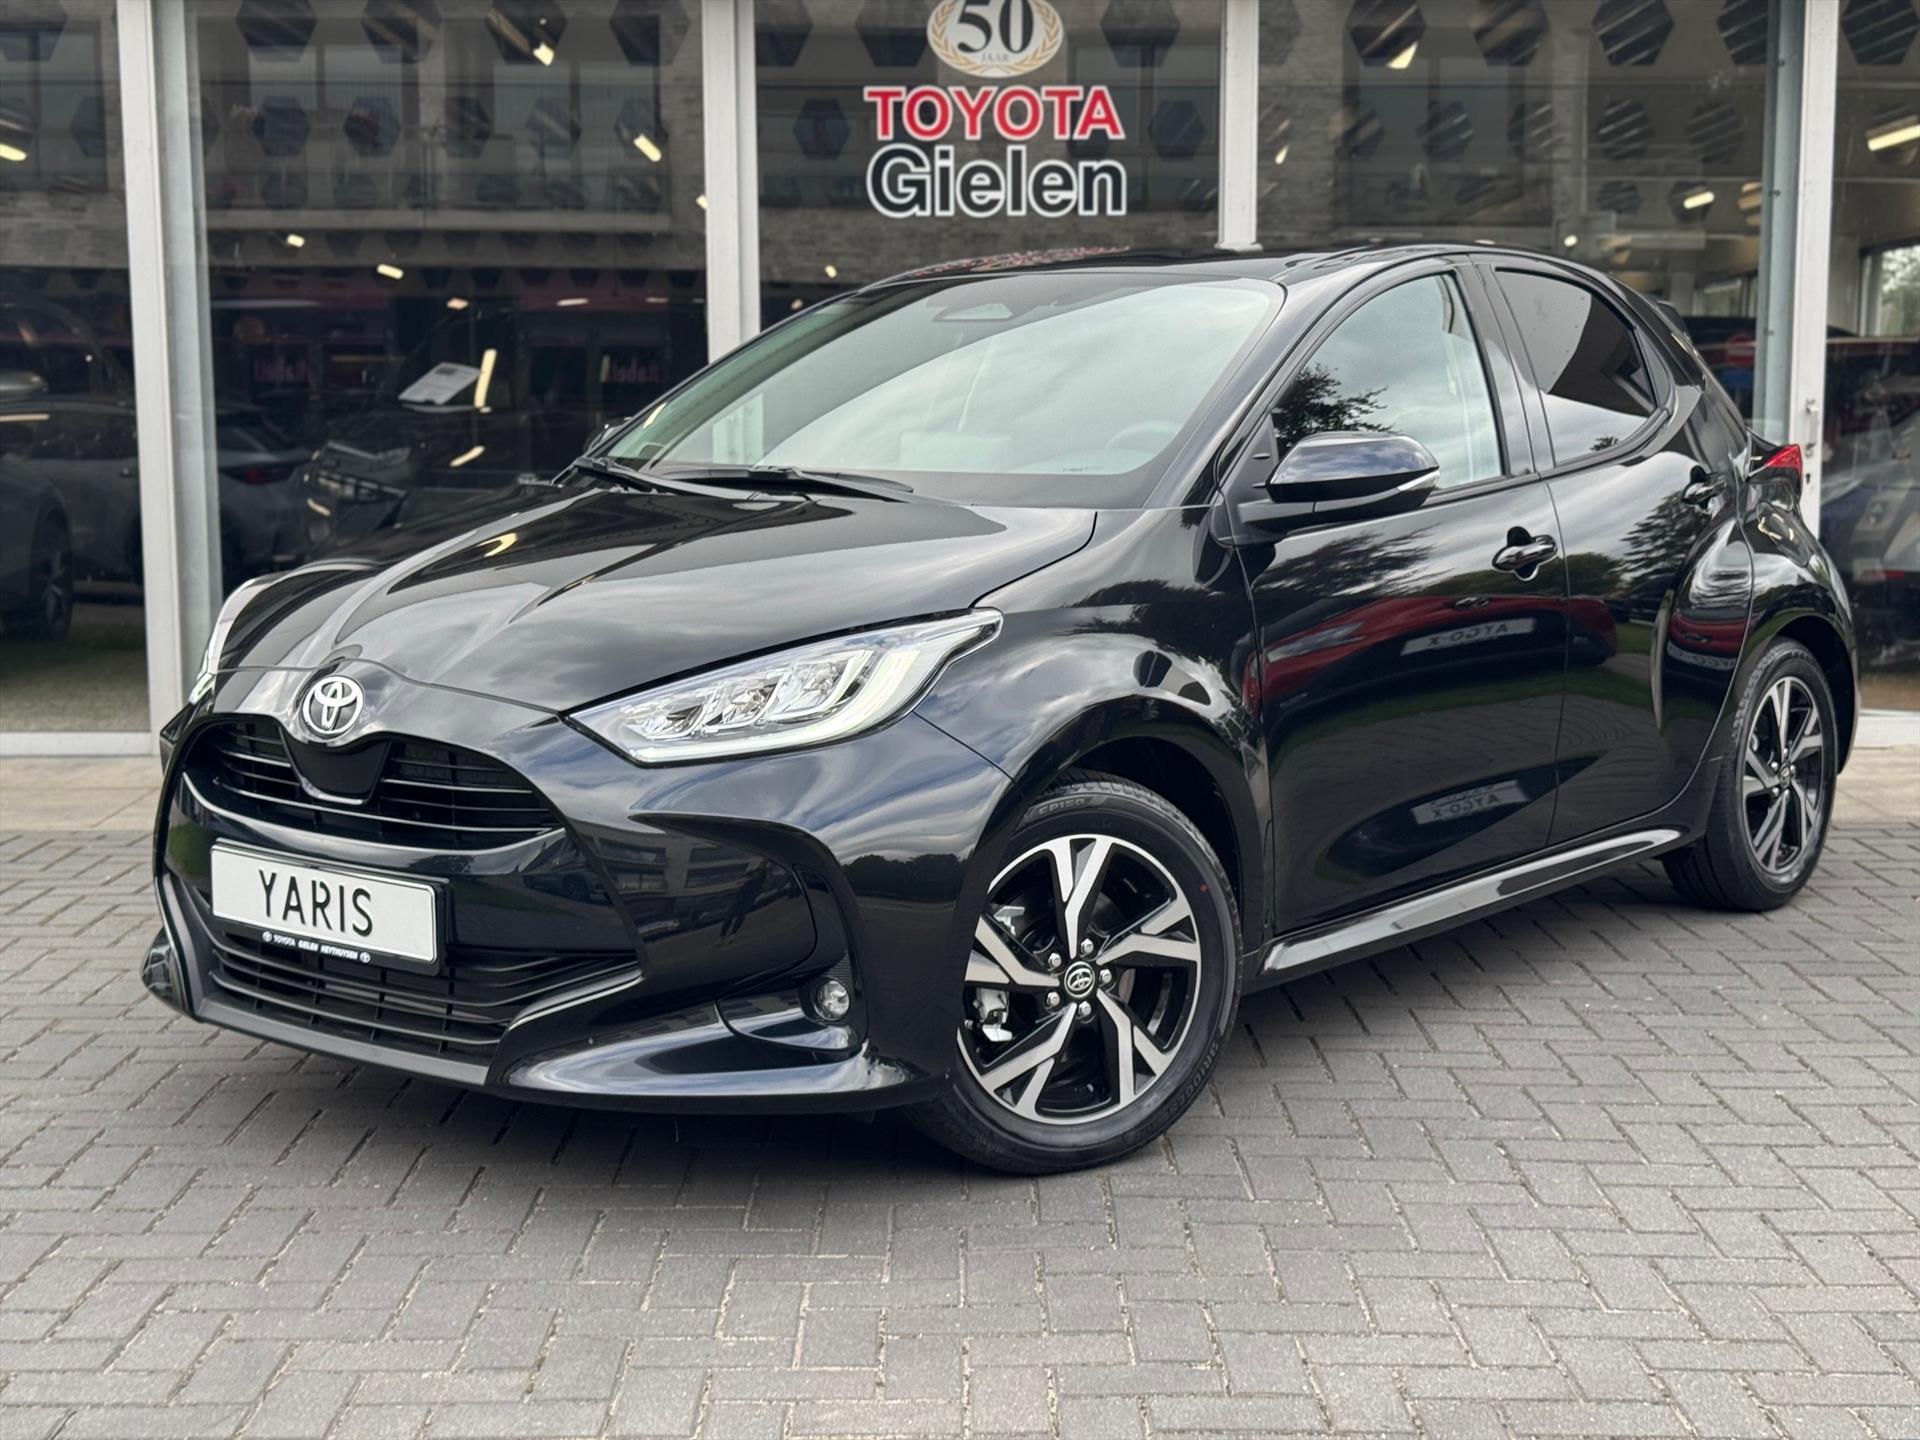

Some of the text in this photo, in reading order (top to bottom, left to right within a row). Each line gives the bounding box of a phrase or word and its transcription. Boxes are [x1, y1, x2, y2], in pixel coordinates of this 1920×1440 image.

[957, 0, 1034, 53] 50
[864, 85, 1126, 140] TOYOTA
[866, 143, 1127, 218] Gielen
[259, 869, 373, 937] YARIS
[274, 934, 296, 946] TOYOTA
